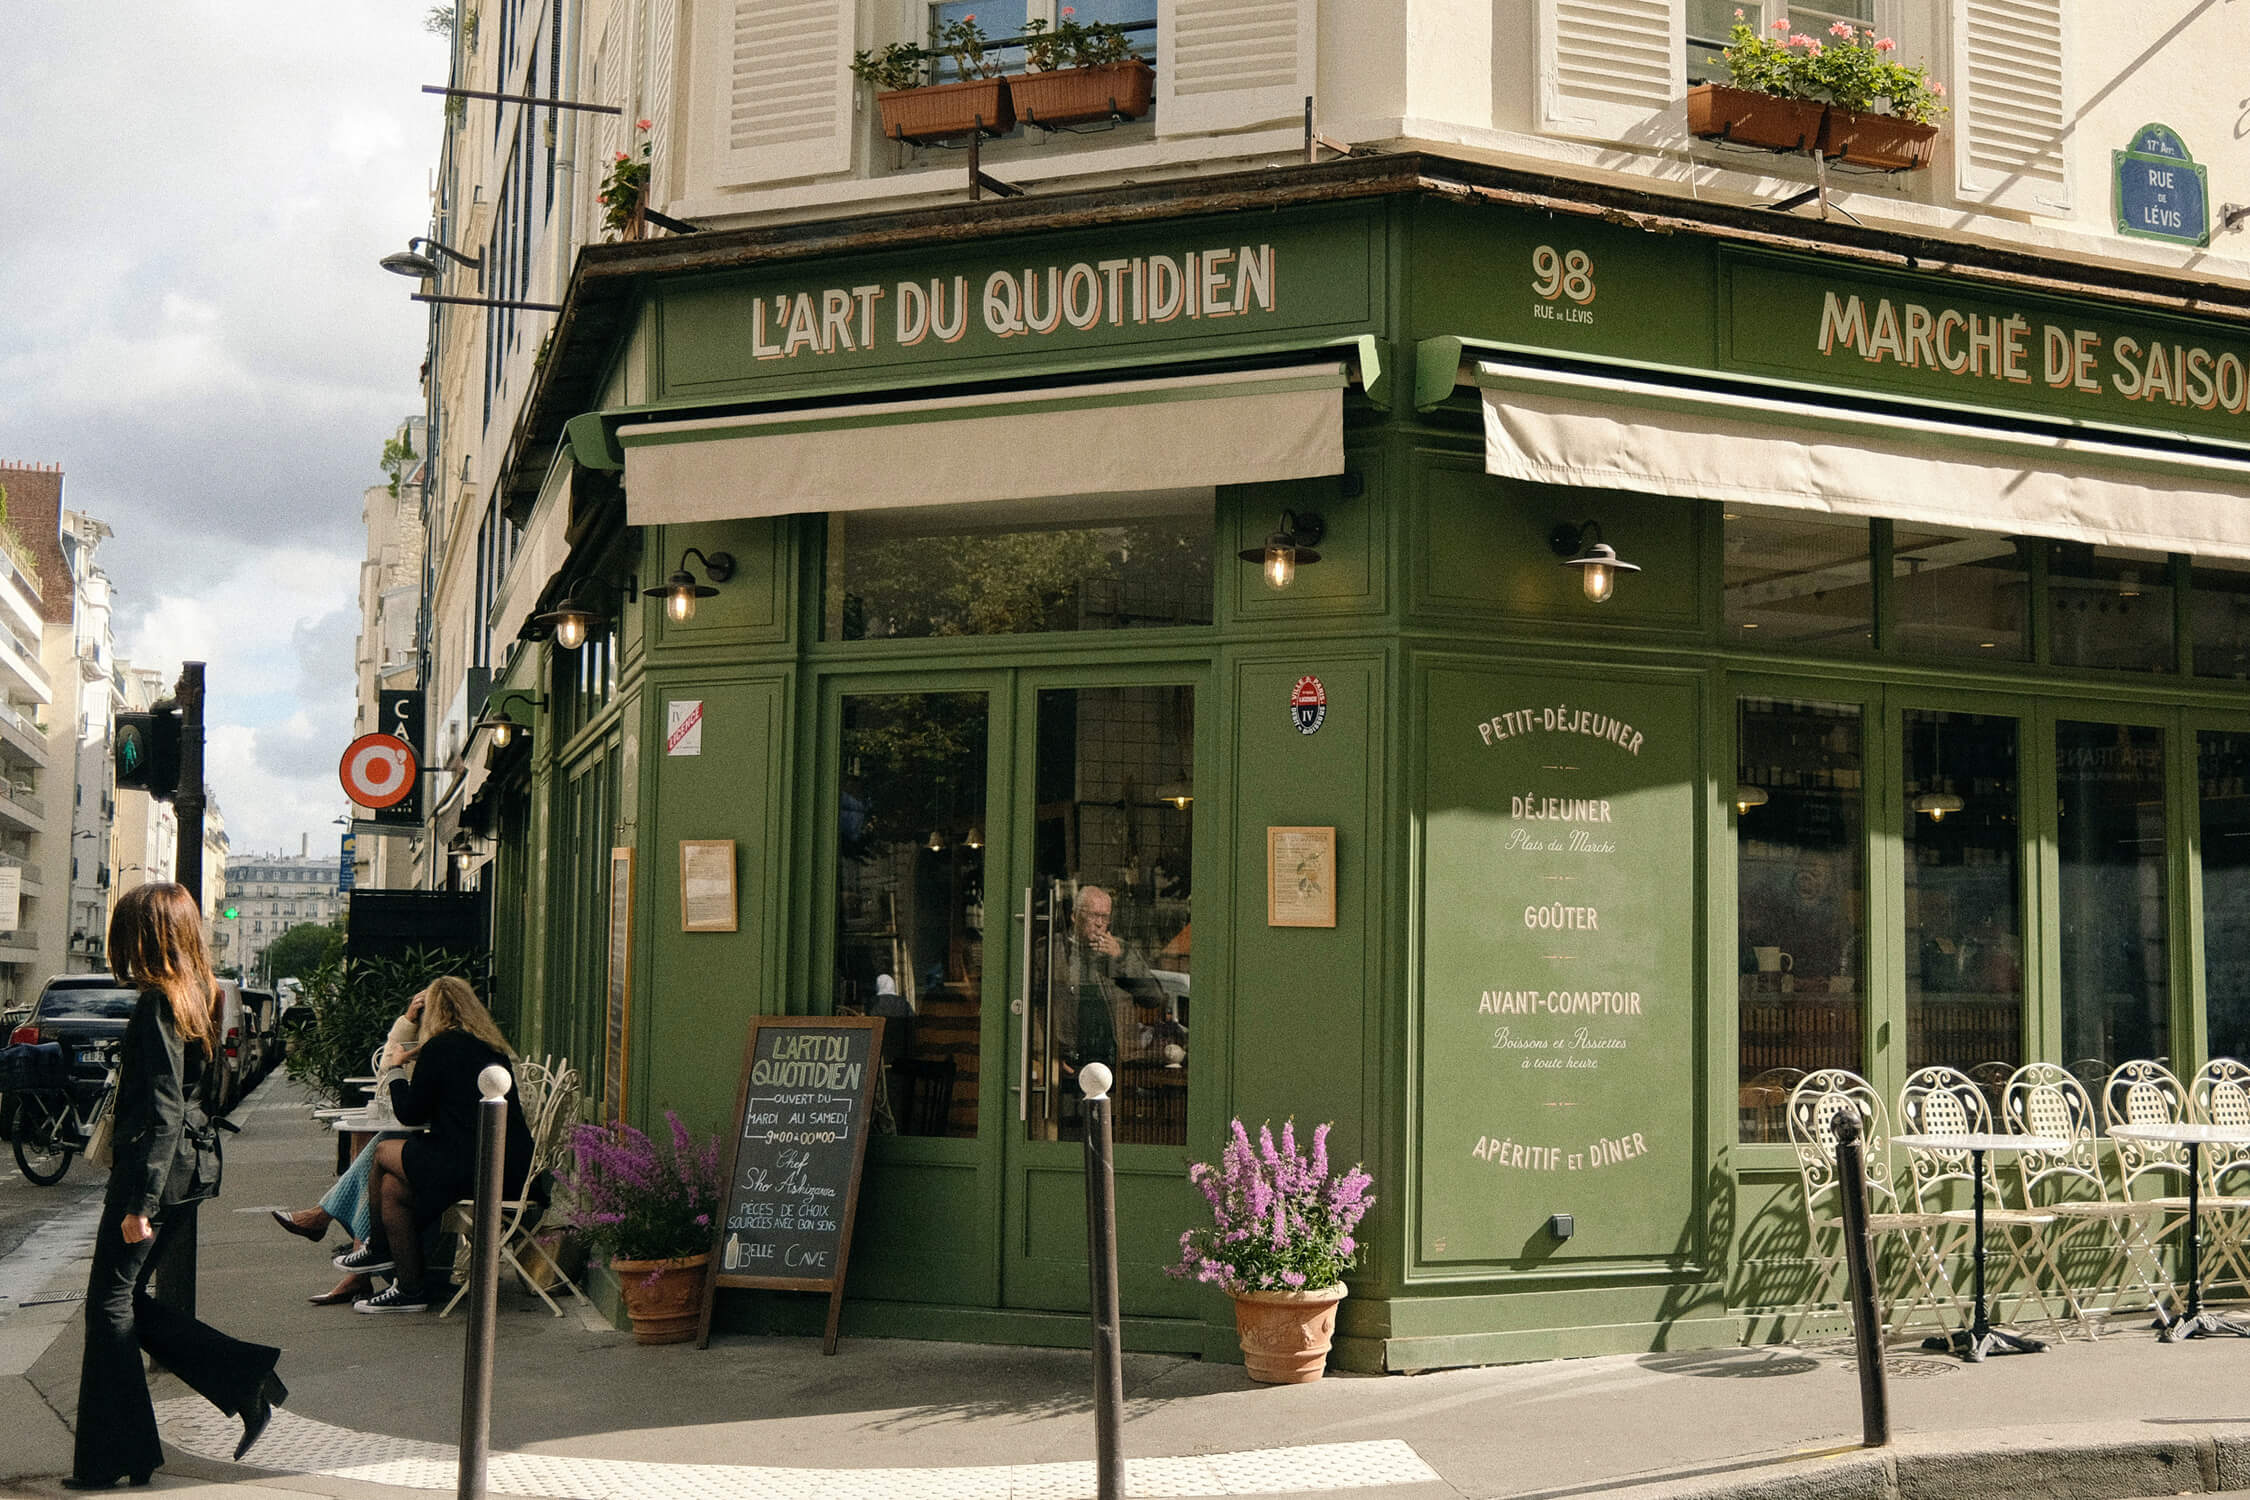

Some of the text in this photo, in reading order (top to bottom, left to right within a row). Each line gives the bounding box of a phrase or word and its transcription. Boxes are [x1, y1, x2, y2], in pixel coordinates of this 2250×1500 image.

[2148, 169, 2174, 189] RUE
[2158, 193, 2167, 203] DE
[2144, 204, 2182, 228] LÉVIS
[1531, 245, 1596, 305] 98
[752, 244, 1275, 360] L'ART DU QUOTIDIEN
[1534, 304, 1555, 320] RUE
[1565, 308, 1594, 325] LÉVIS
[1817, 291, 2250, 415] MARCHÉ DE SAISO
[1302, 710, 1314, 722] IV
[1477, 703, 1644, 757] PETIT-DÉJEUNER
[1511, 791, 1612, 824] DÉJEUNER
[1504, 828, 1616, 854] Plats du Marché
[1524, 901, 1600, 930] GOÛTER
[1478, 990, 1643, 1016] AVANT-COMPTOIR
[772, 1035, 850, 1062] L'ART DU
[1493, 1026, 1627, 1049] Boissons et Assiettes
[751, 1059, 862, 1090] QUOTIDIEN
[1521, 1056, 1598, 1069] à toute heure
[774, 1093, 832, 1105] OUVERT DU
[747, 1111, 848, 1125] MARDI AU SAMEDI
[776, 1148, 810, 1174] Chef
[1472, 1132, 1649, 1171] APÉRITIF ET DÎNER
[742, 1167, 773, 1192] Sho
[780, 1203, 795, 1216] DE
[798, 1203, 830, 1217] CHOIX
[774, 1217, 795, 1230] AVEC
[797, 1218, 815, 1231] BON
[816, 1220, 837, 1232] SENS
[738, 1243, 829, 1268] BELLE CAVE
